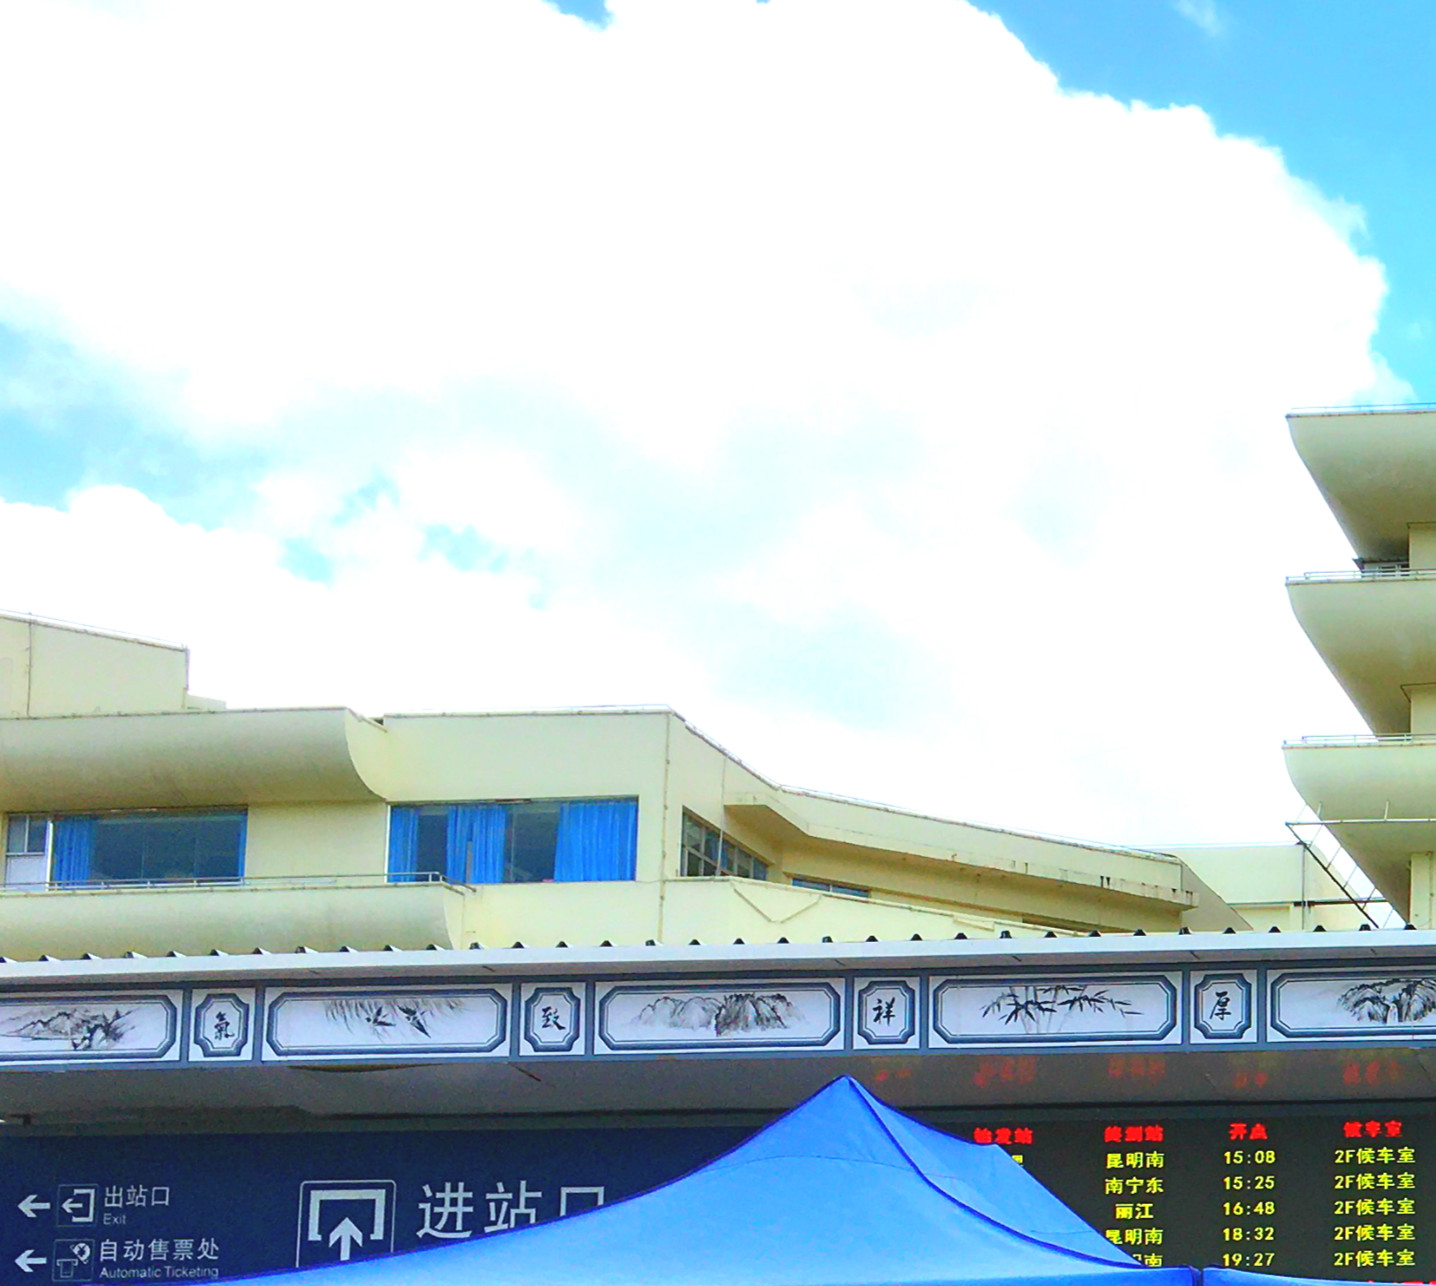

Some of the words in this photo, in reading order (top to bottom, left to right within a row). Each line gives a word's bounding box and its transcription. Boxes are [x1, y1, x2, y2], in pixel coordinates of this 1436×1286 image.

[872, 998, 896, 1024] 祥
[1208, 992, 1231, 1020] 厚
[1229, 1122, 1268, 1141] 开点
[1106, 1150, 1164, 1169] 昆明南
[1223, 1150, 1276, 1165] 15:08
[1334, 1146, 1415, 1165] 2F候车室
[1105, 1176, 1164, 1195] 南宁东
[1223, 1175, 1276, 1190] 15:25
[1334, 1171, 1415, 1190] 2F候车室
[104, 1184, 170, 1208] 出站口
[103, 1213, 127, 1225] Exit
[416, 1179, 605, 1239] 进站口
[1115, 1202, 1154, 1220] 丽江
[1223, 1201, 1276, 1216] 16:48
[1334, 1197, 1415, 1216] 2F候车室
[1105, 1227, 1164, 1246] 昆明南
[1223, 1226, 1276, 1242] 18:32
[1334, 1222, 1415, 1242] 2F候车室
[99, 1237, 220, 1262] 自动售票处
[1223, 1252, 1276, 1267] 19:27
[1334, 1248, 1415, 1268] 2F候车室
[100, 1266, 159, 1279] Automatic
[164, 1265, 220, 1279] Ticketing
